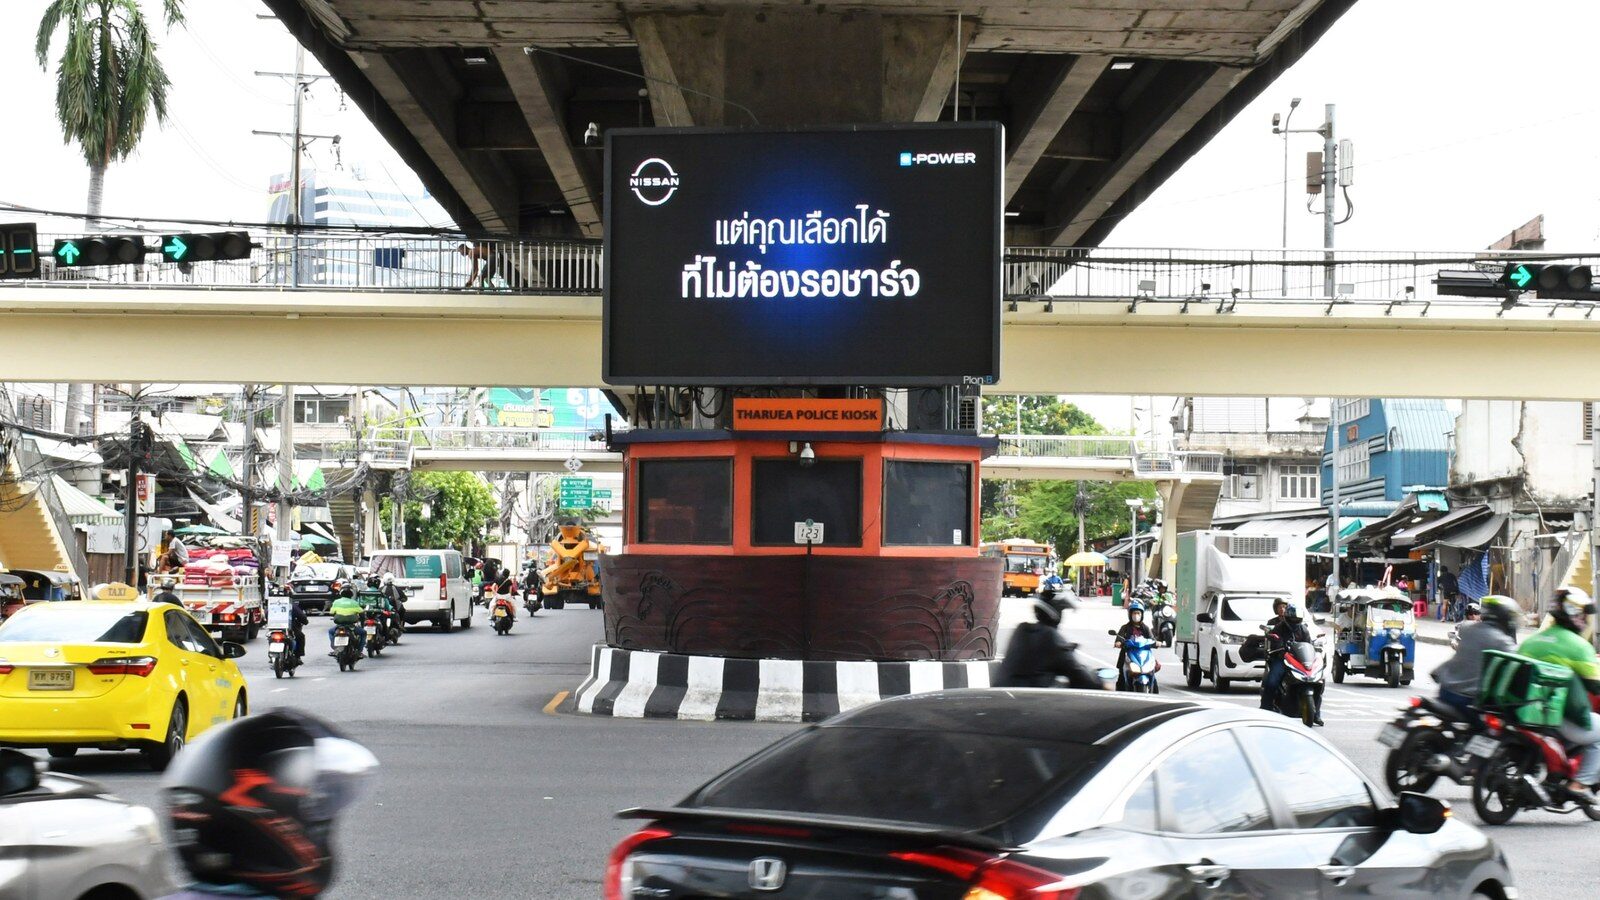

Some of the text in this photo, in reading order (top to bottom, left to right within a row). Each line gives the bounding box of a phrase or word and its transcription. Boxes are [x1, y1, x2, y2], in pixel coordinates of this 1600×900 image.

[900, 152, 977, 166] -POWER
[630, 177, 679, 187] NISSAN
[715, 204, 891, 254] แต่คุณเลือกได้
[681, 255, 921, 298] ที่ไม่ต้องรอชาร์จ
[736, 409, 878, 420] THARUEA POLICE KIOSK
[801, 528, 819, 539] 123
[108, 588, 126, 596] TAXI
